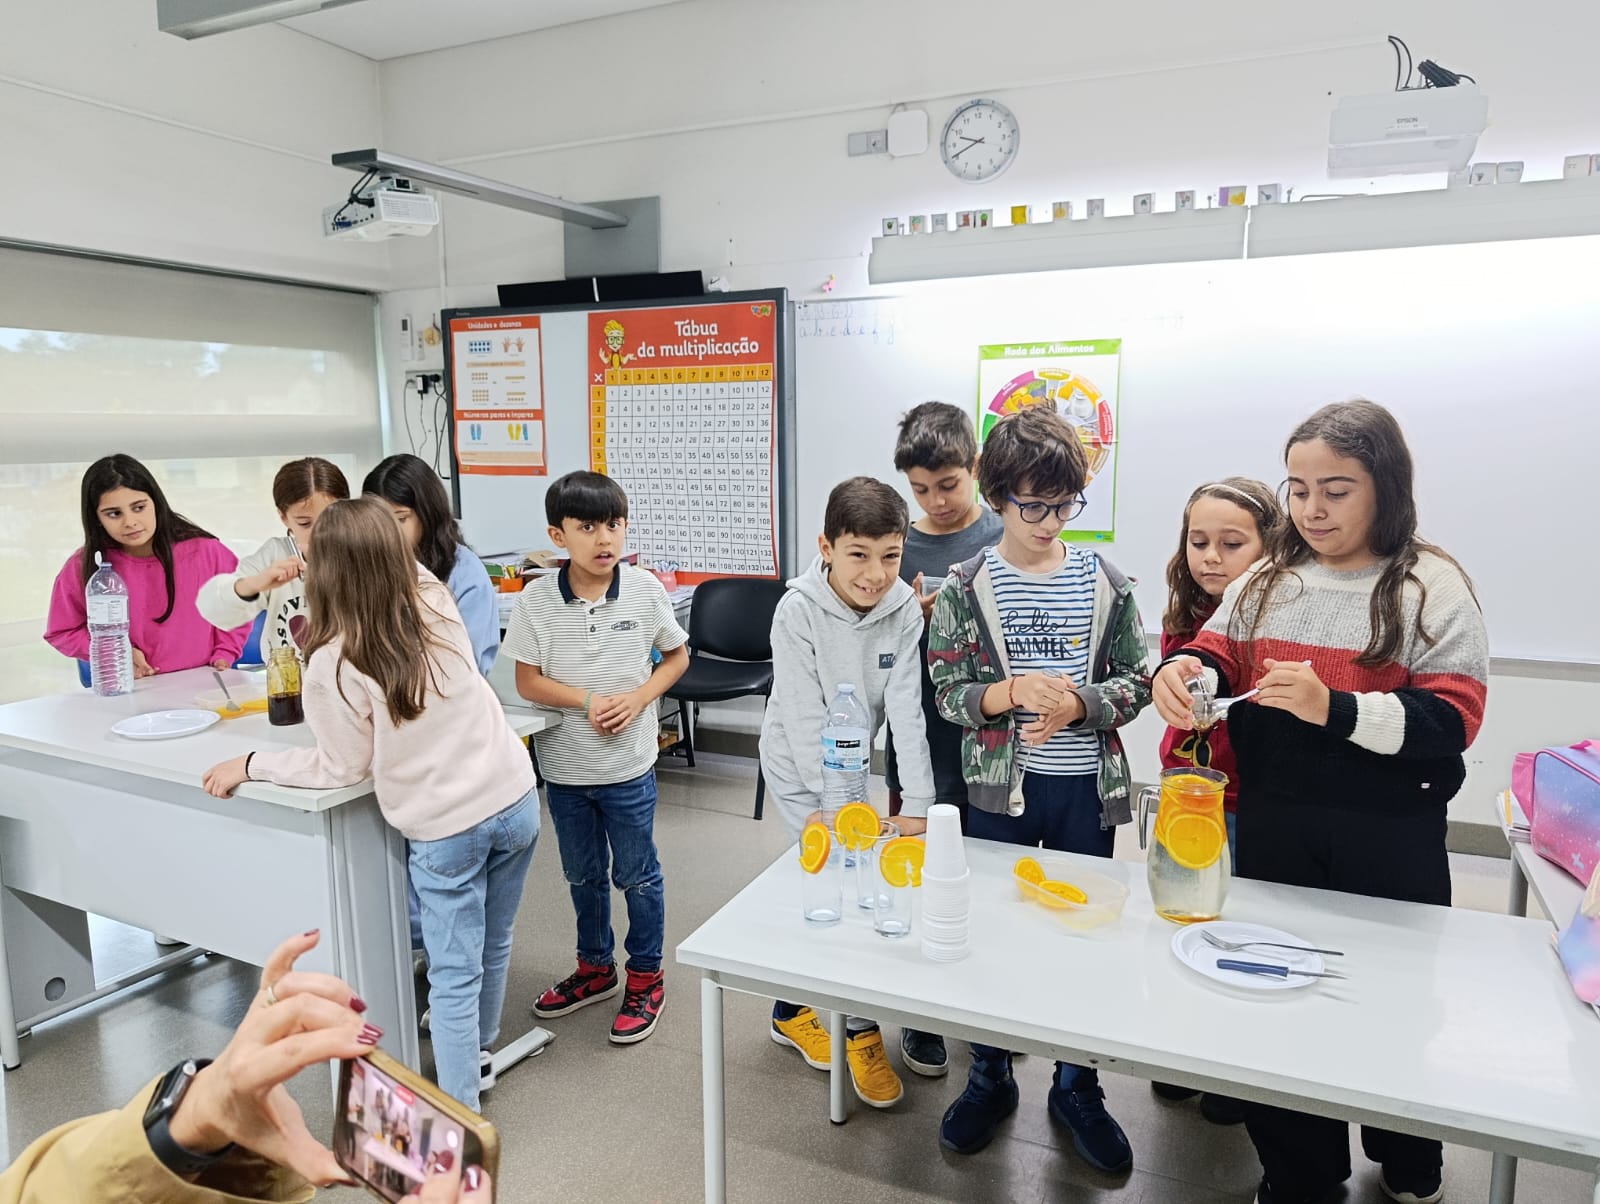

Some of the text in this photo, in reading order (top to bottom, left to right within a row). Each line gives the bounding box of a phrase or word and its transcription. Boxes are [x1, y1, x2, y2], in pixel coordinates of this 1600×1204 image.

[674, 320, 718, 336] Tábua
[637, 337, 759, 360] da multiplicação
[1005, 344, 1094, 355] Roda dos Alimentos
[1002, 608, 1068, 632] hello
